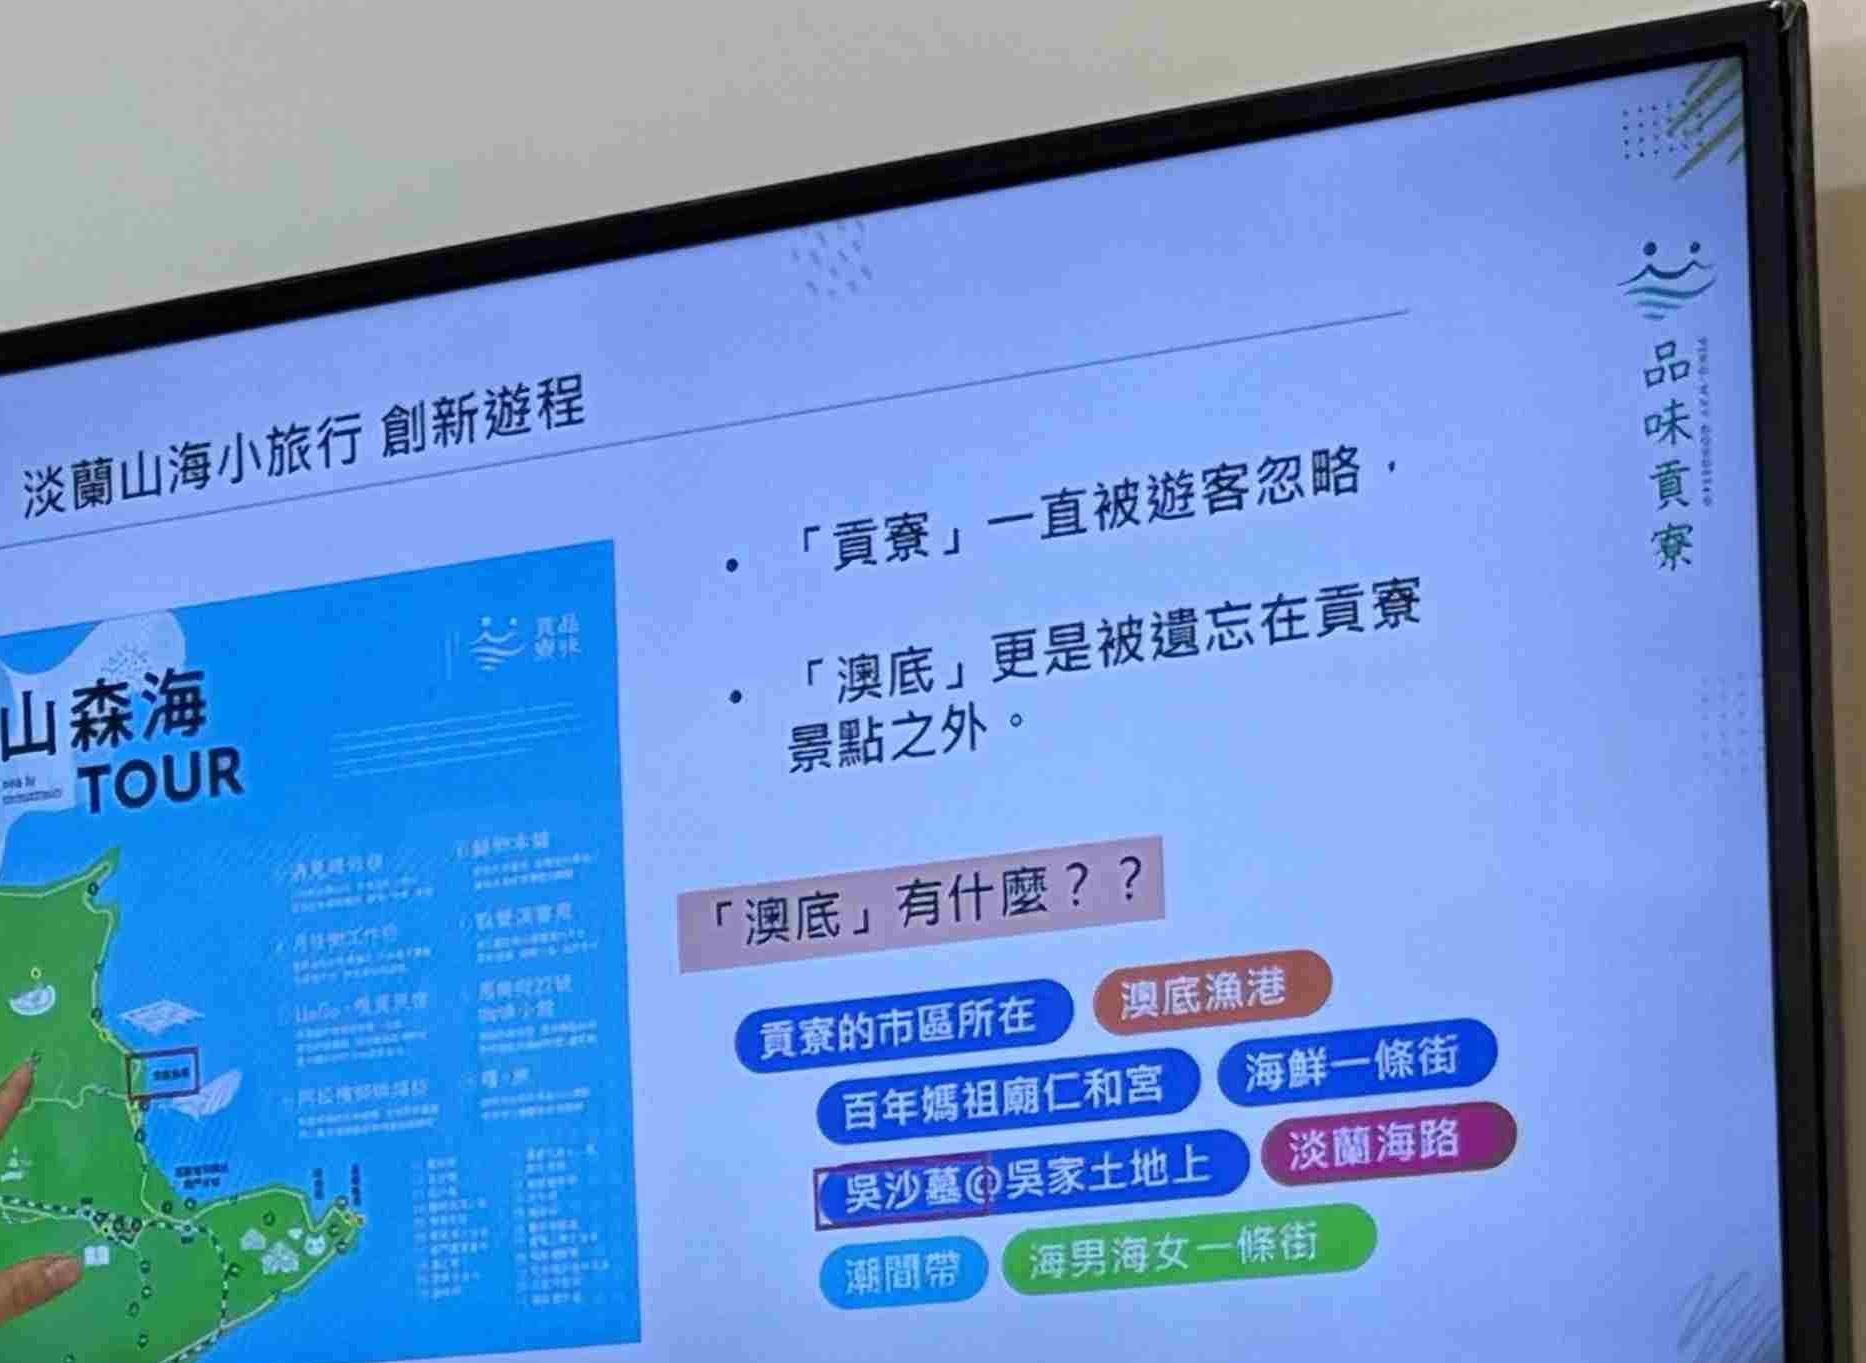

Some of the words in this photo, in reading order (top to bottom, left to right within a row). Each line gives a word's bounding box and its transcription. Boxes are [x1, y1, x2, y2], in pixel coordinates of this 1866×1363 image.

[22, 413, 363, 519] 淡蘭山海小旅行
[381, 373, 586, 458] 創新遊程
[1642, 340, 1693, 572] 品味貢寮
[804, 575, 1421, 703] 「澳底」更是被遺忘在貢寮
[0, 669, 207, 761] 山森海
[788, 701, 1024, 774] 景點之外。
[77, 745, 244, 815] TOUR
[714, 856, 1144, 947] 「澳底」有什麼？？
[1120, 964, 1287, 1019] 澳底漁港
[760, 995, 1037, 1061] 貢寮的市區所在
[842, 1062, 1164, 1130] 百年媽祖廟仁和宮
[1246, 1037, 1459, 1093] 海鮮一條街
[1289, 1122, 1459, 1171] 淡蘭海路
[844, 1247, 960, 1295] 潮間帶
[1029, 1220, 1317, 1280] 海男海女一條街
